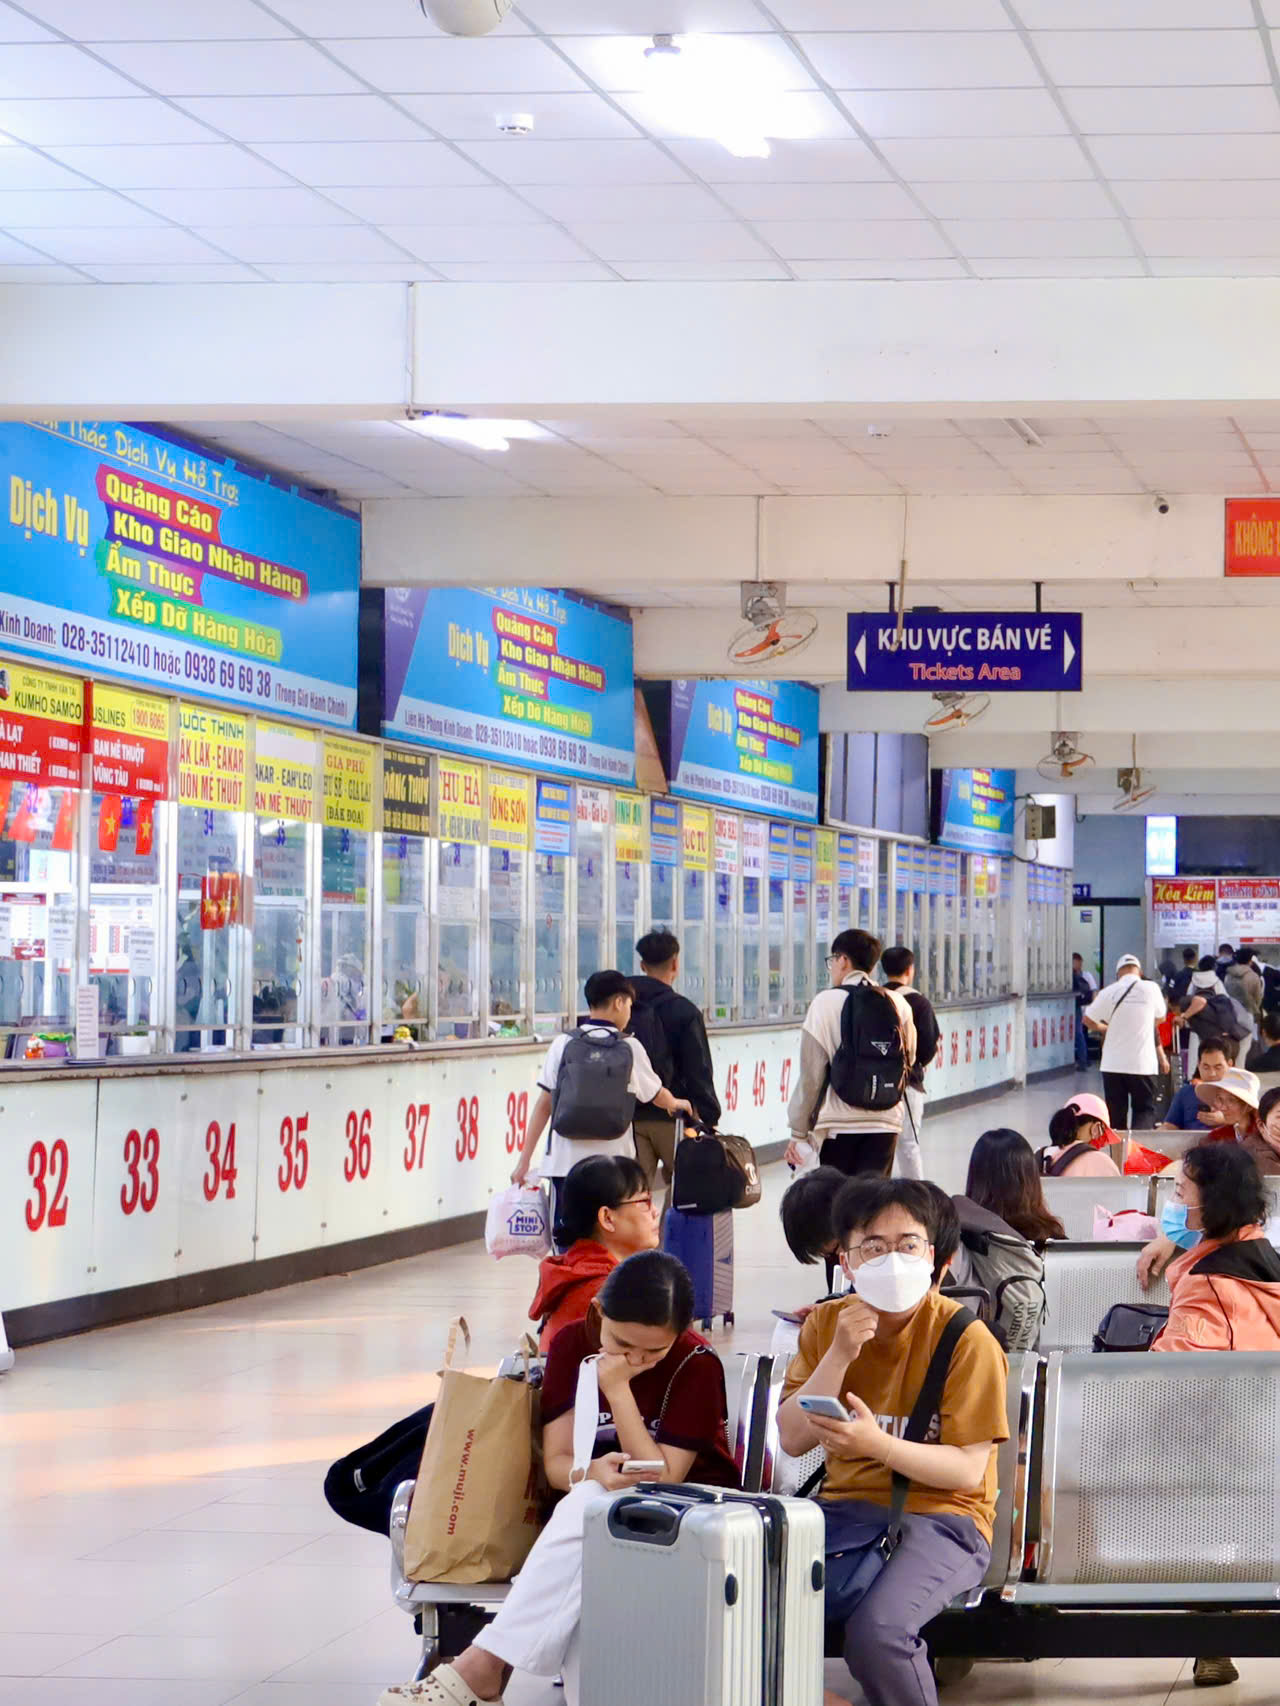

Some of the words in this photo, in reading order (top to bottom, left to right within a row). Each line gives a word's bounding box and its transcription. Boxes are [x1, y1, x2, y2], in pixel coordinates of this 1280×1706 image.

[9, 475, 58, 540] Dịch
[63, 495, 90, 557] Vụ
[105, 473, 171, 521] Quảng
[175, 498, 213, 534] Cáo
[113, 511, 154, 545] Kho
[160, 529, 204, 563] Giao
[208, 544, 255, 580] Nhận
[260, 562, 302, 598] Hàng
[1234, 511, 1274, 557] KHÔNG
[106, 541, 141, 576] Ẩm
[147, 563, 195, 597] Thực
[115, 584, 156, 624] Xếp
[161, 607, 187, 631] Dỡ
[192, 611, 239, 648] Hàng
[244, 628, 278, 657] Hóa
[497, 612, 531, 642] Quảng
[533, 625, 554, 648] Cáo
[878, 628, 923, 651] KHU
[927, 625, 973, 657] VỰC
[977, 623, 1021, 651] BÁN
[1025, 623, 1052, 651] VÉ
[62, 622, 151, 667] 028-35112410
[153, 646, 182, 681] hoặc
[184, 650, 217, 685] 0938
[220, 660, 236, 690] 69
[239, 665, 254, 694] 69
[256, 671, 271, 699] 38
[501, 638, 523, 661] Kho
[525, 646, 549, 670] Giao
[551, 655, 577, 680] Nhận
[578, 663, 603, 689] Hàng
[909, 662, 975, 681] Tickets
[978, 663, 1022, 681] Area
[14, 691, 48, 713] KUMHO
[50, 699, 82, 720] SAMCO
[93, 707, 126, 728] USLINES
[7, 724, 24, 748] LẠT
[94, 738, 111, 757] BAN
[0, 752, 16, 771] HAN
[17, 750, 42, 774] THIẾT
[180, 767, 199, 800] UÔN
[255, 791, 267, 811] AN
[725, 1061, 738, 1112] 45
[752, 1061, 766, 1107] 46
[780, 1058, 792, 1102] 47
[344, 1108, 372, 1183] 36
[404, 1103, 430, 1172] 37
[456, 1095, 479, 1162] 38
[505, 1091, 528, 1154] 39
[120, 1127, 160, 1216] 33
[203, 1120, 238, 1201] 34
[278, 1111, 309, 1192] 35
[25, 1138, 69, 1232] 32
[514, 1224, 539, 1233] STOP
[515, 1216, 539, 1226] MINI
[447, 1428, 475, 1537] www.muji.com
